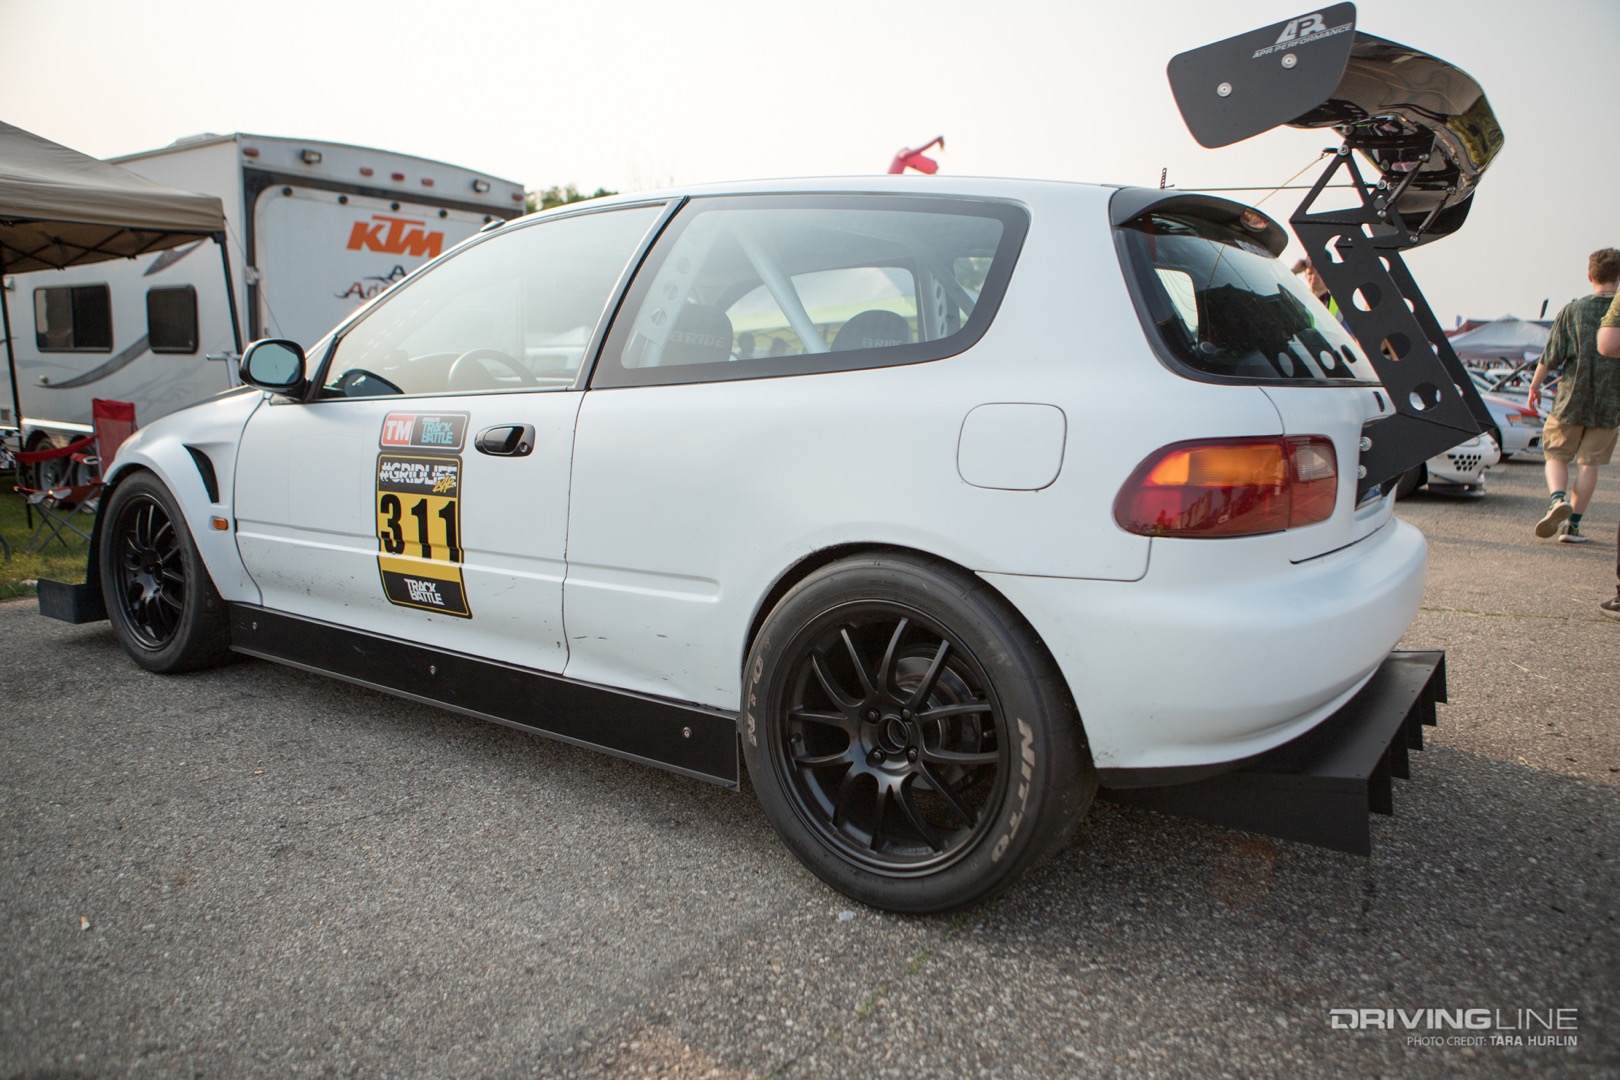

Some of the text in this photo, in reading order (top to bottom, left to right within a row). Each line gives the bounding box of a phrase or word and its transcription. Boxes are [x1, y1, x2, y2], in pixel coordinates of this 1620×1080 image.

[1252, 22, 1353, 59] APR PERFORMANCE
[346, 214, 444, 258] KTM
[669, 330, 726, 348] BRIDE
[386, 420, 412, 441] TM
[422, 421, 453, 433] TRACK
[421, 432, 453, 444] BATTLE
[379, 462, 458, 487] #GRIDLIFE
[380, 493, 460, 564] 311
[403, 578, 436, 593] TRACK
[411, 590, 445, 606] BATTLE
[991, 717, 1035, 863] NITTO
